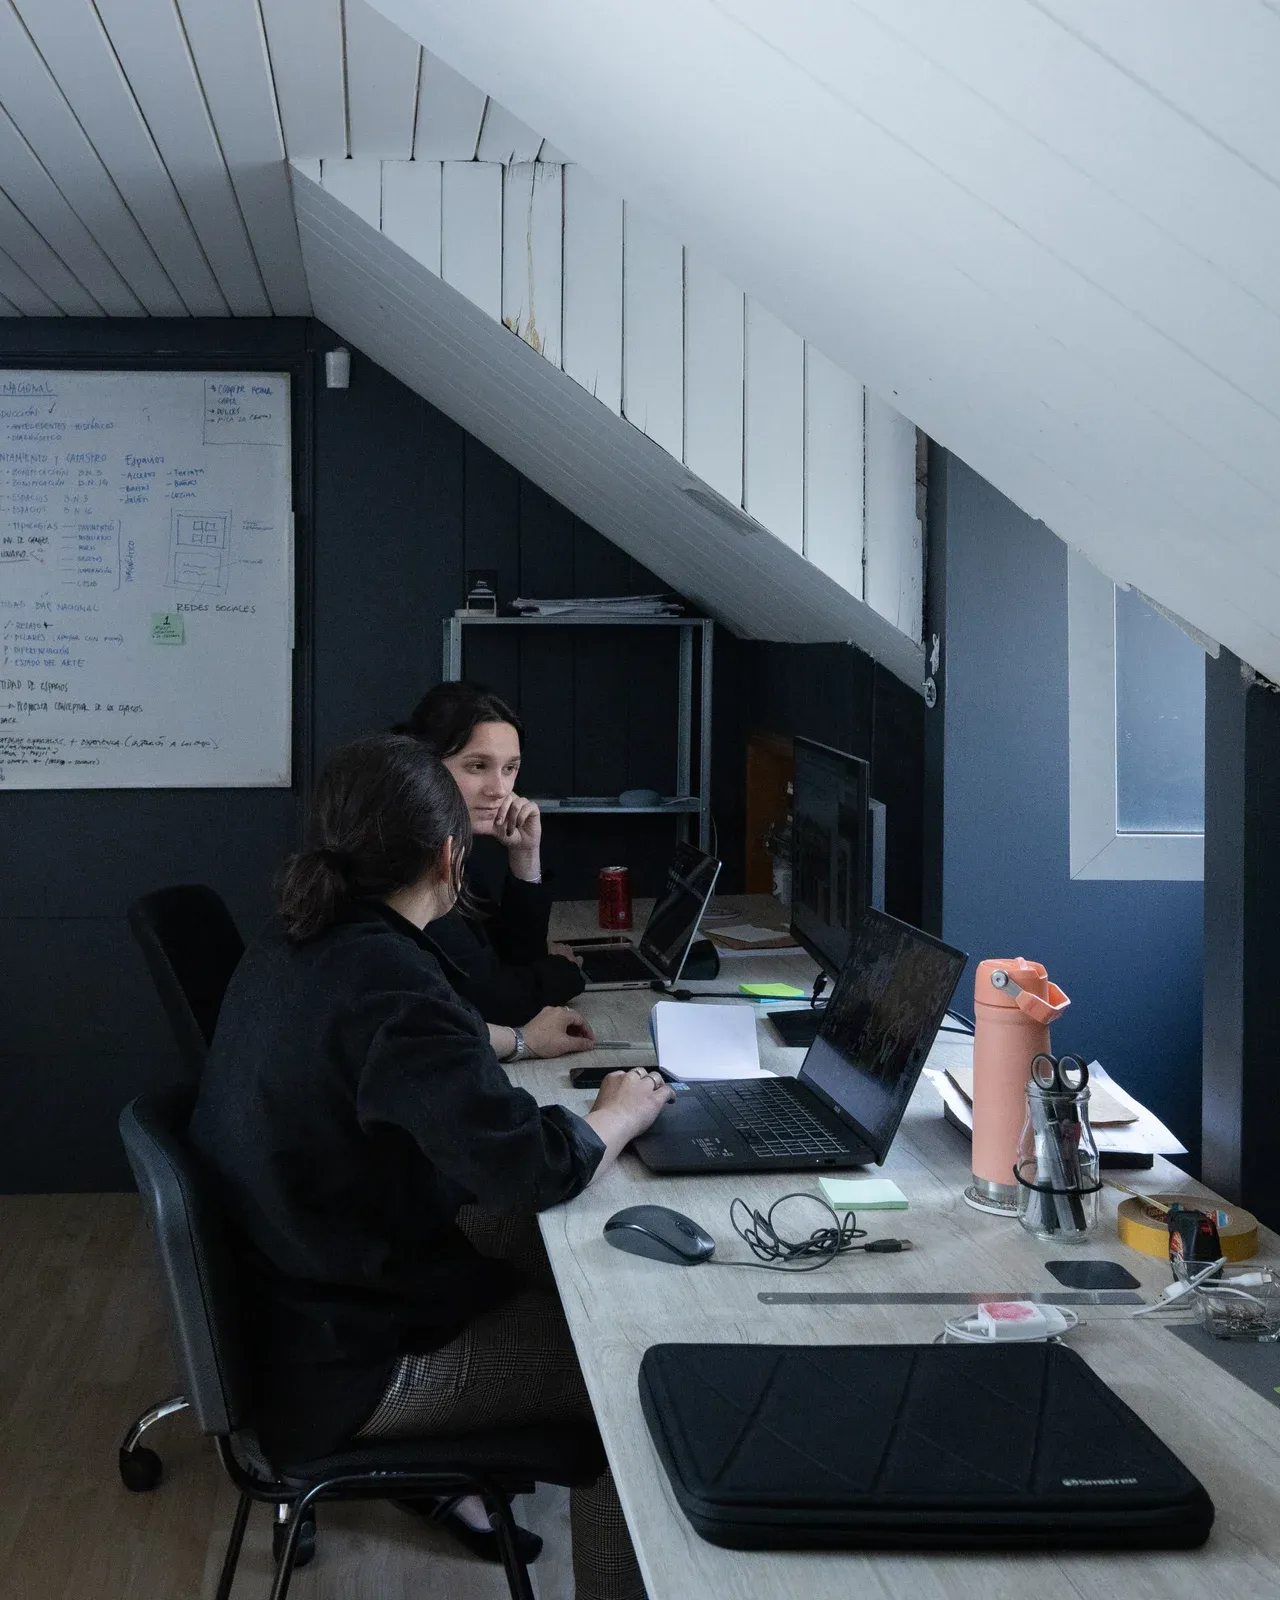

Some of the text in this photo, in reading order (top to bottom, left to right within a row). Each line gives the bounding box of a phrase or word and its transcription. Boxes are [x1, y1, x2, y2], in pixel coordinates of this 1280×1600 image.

[176, 602, 257, 614] REDES SOCIALES
[163, 615, 171, 625] 1
